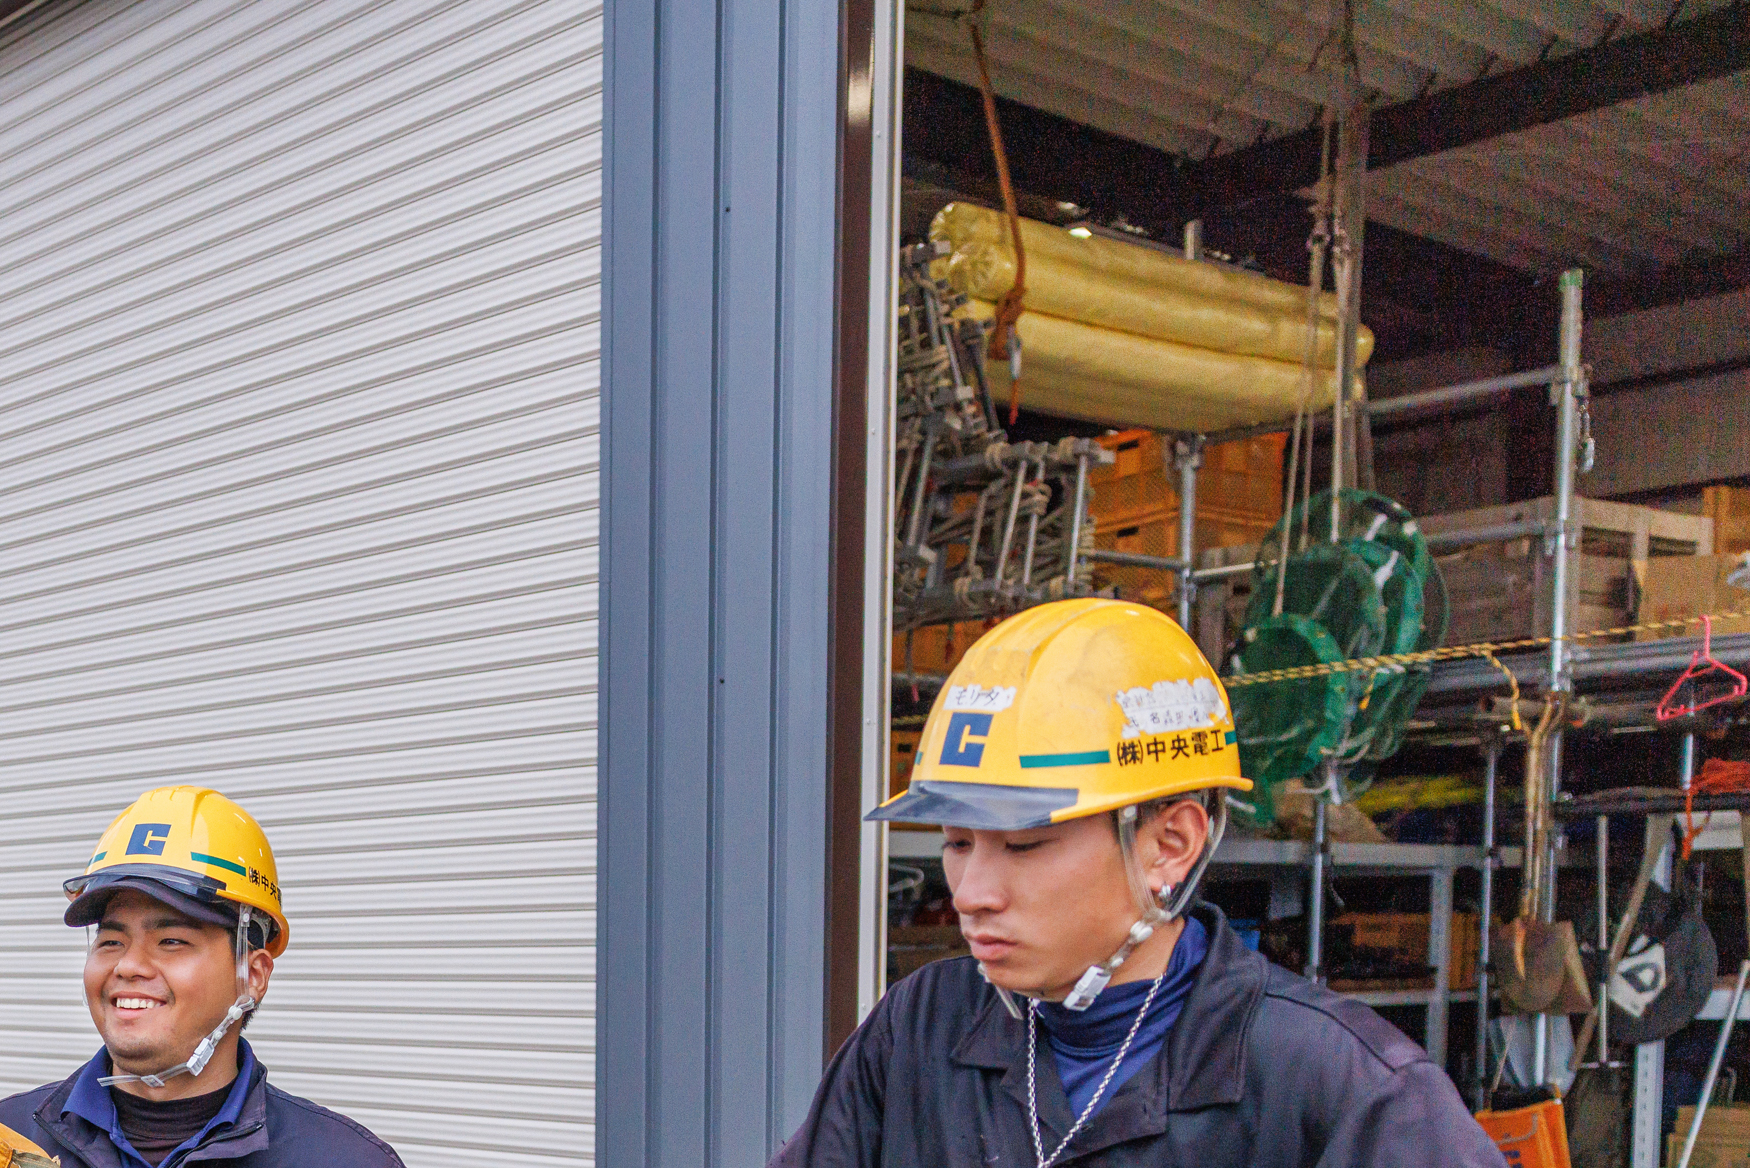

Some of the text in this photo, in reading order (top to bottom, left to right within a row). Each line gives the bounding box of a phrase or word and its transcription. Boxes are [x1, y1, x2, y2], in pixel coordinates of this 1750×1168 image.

[1117, 729, 1225, 767] (株)中央電工
